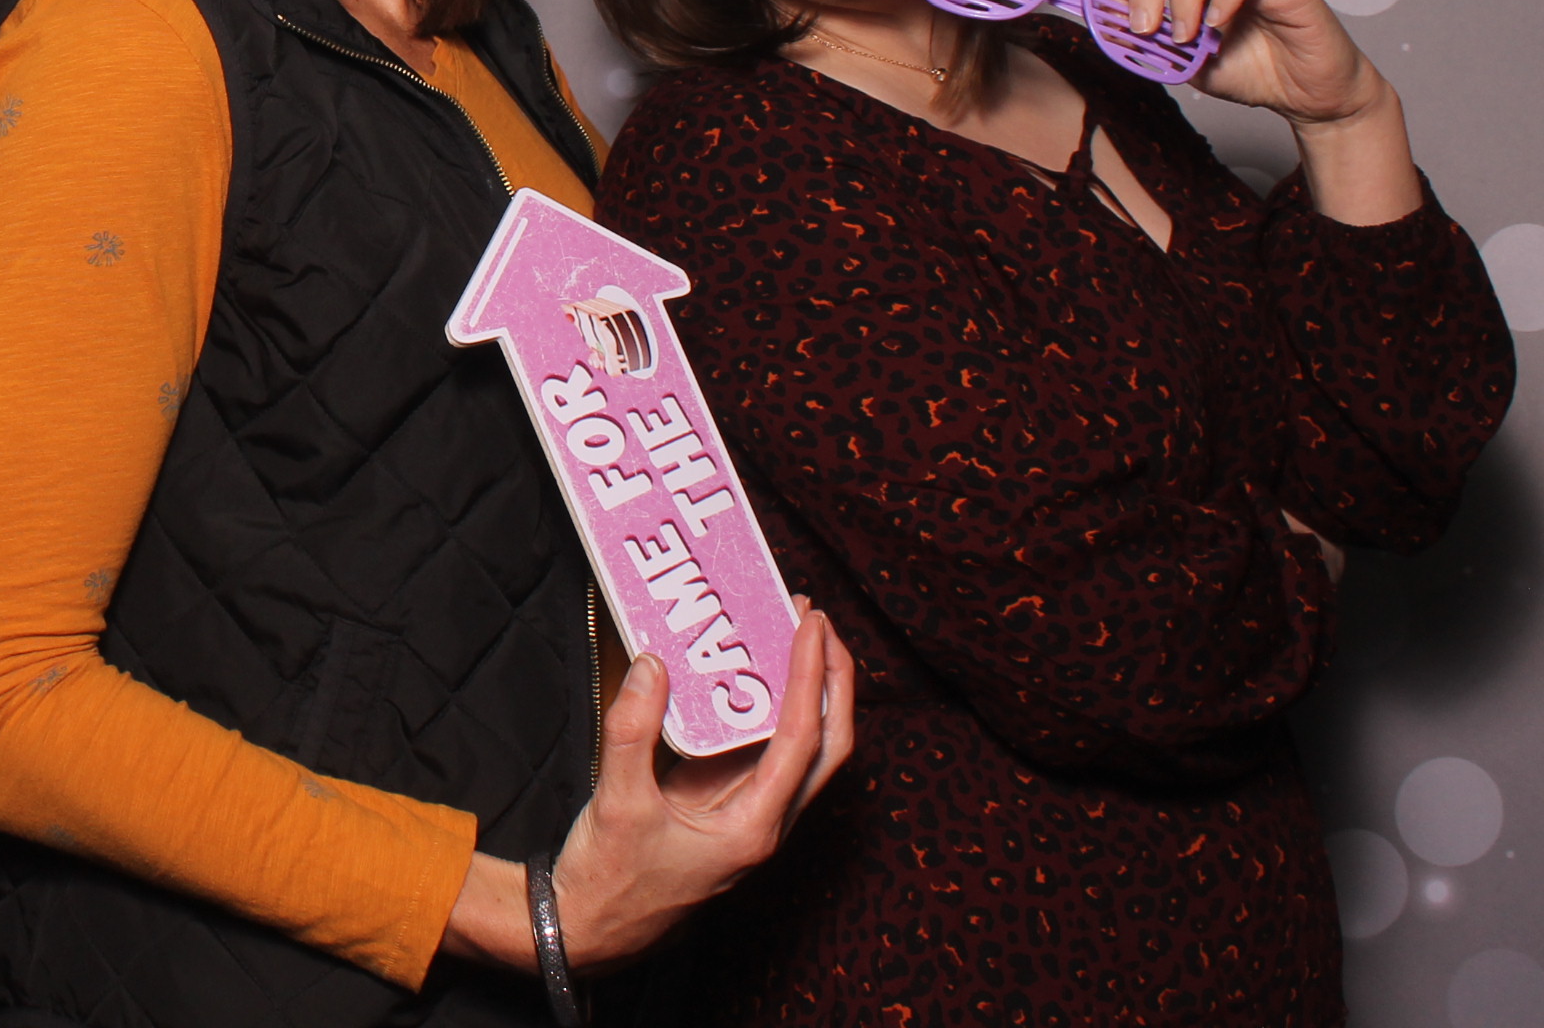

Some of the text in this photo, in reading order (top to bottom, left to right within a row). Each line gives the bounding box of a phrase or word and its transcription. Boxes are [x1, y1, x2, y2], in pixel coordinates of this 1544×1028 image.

[541, 362, 771, 729] CAME FOR
[627, 394, 735, 537] THE
